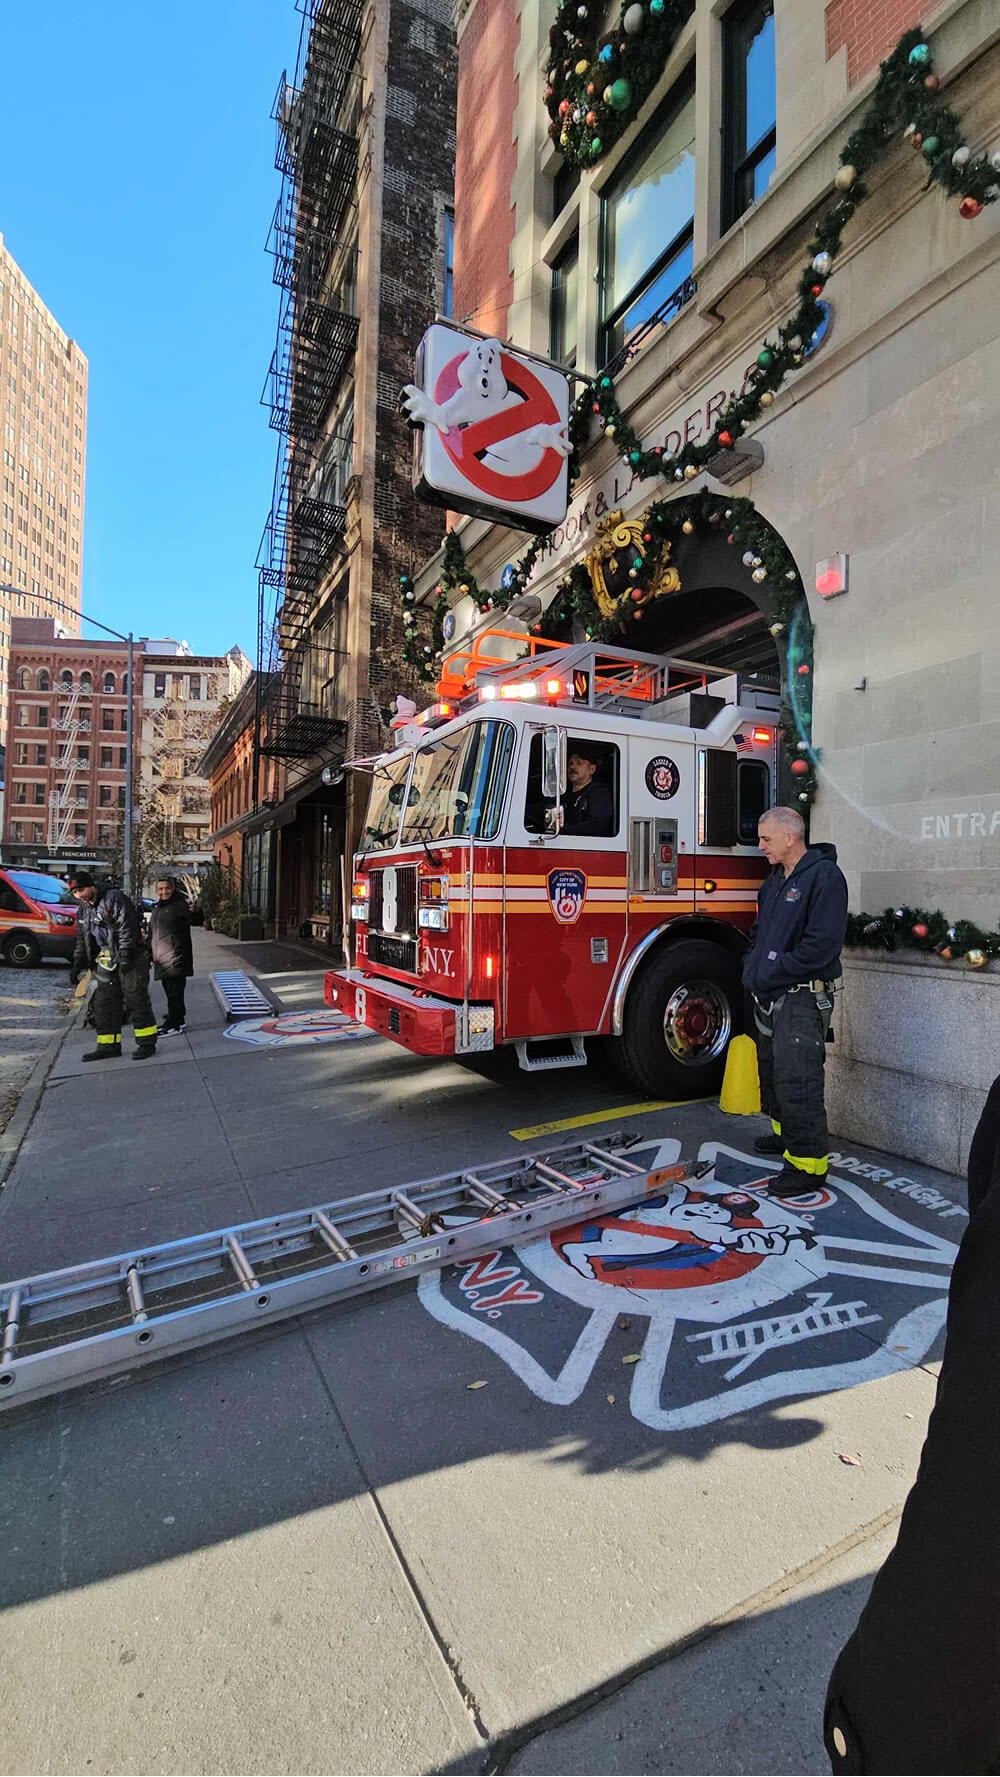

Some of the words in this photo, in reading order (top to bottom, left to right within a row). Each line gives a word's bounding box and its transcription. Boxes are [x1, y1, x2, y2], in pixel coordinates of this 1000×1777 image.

[595, 492, 609, 517] &
[382, 867, 397, 933] 8
[355, 988, 366, 1023] 8
[882, 1177, 970, 1217] EIGHT
